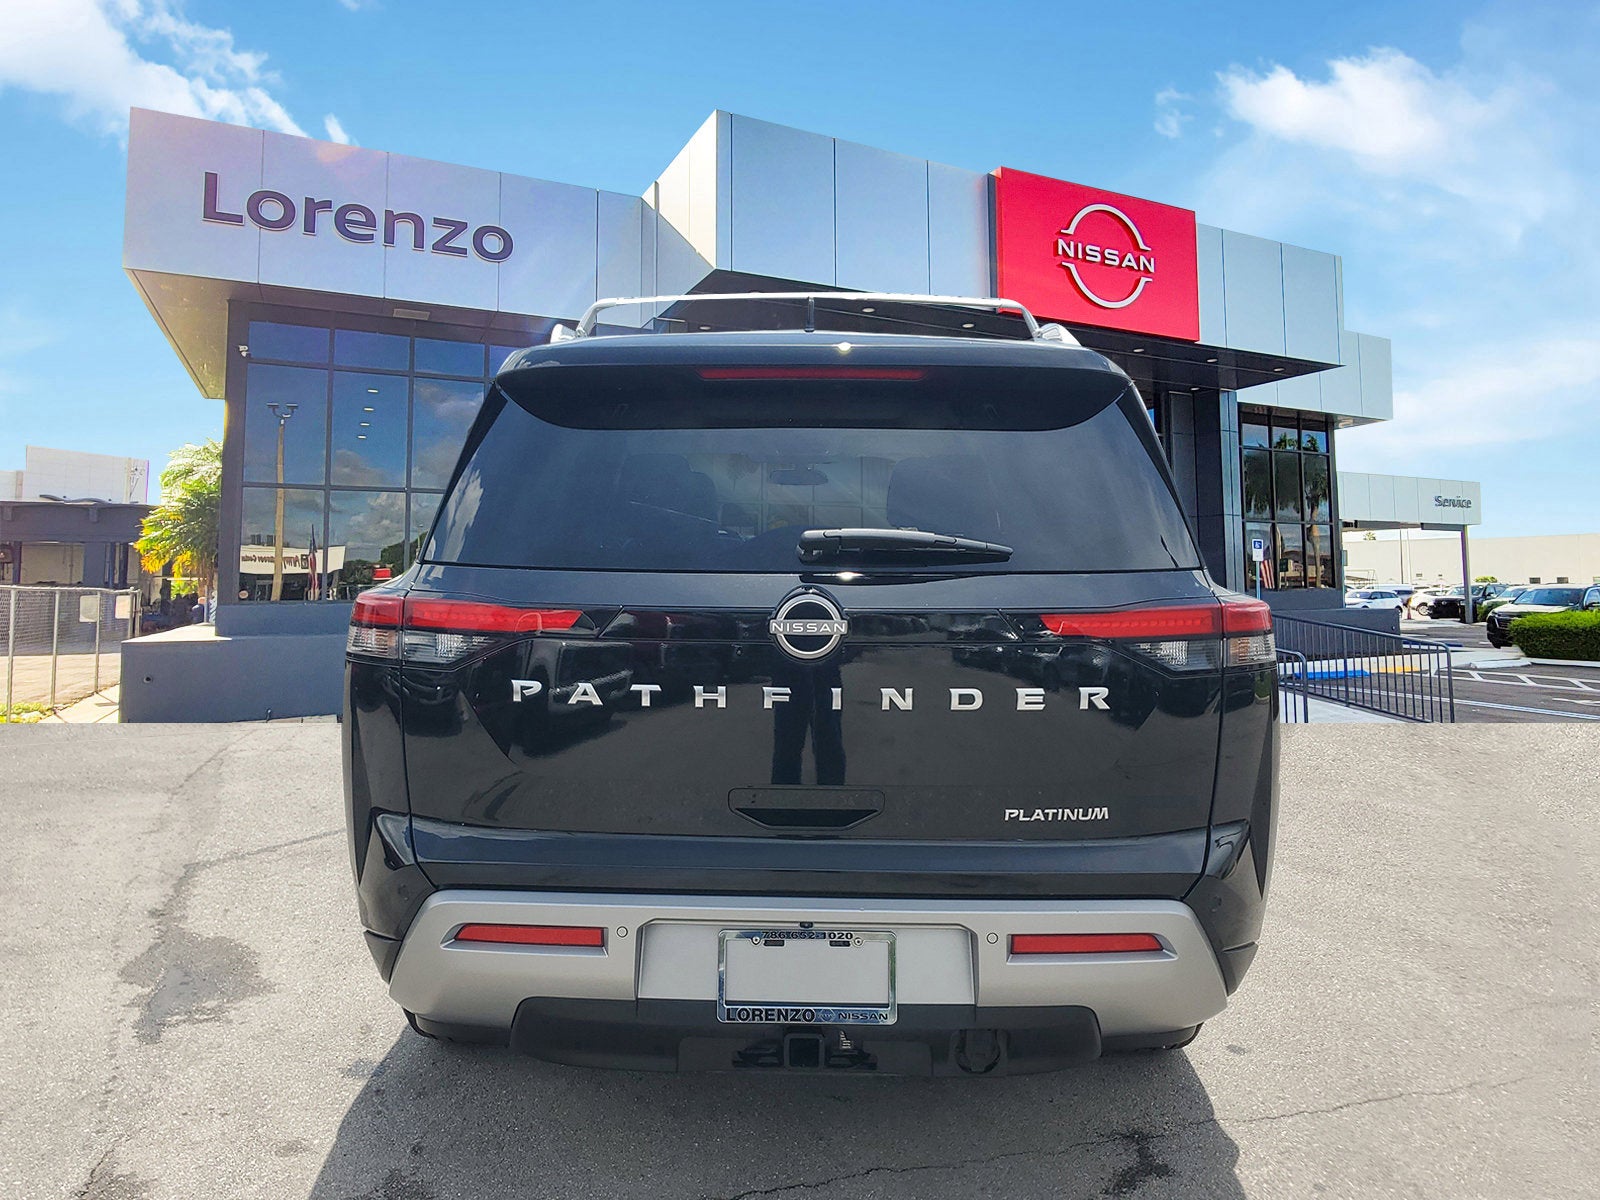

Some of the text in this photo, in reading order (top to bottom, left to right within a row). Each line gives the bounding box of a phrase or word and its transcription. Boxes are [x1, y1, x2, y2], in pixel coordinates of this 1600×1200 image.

[202, 171, 514, 262] Lorenzo
[1057, 238, 1155, 273] NISSAN
[1434, 495, 1472, 509] Service
[772, 622, 845, 633] NISSAN
[511, 679, 1111, 711] PATHFINDER
[1003, 807, 1109, 822] PLATINUM
[726, 1008, 816, 1023] LORENZO
[837, 1012, 889, 1021] NISSAN
